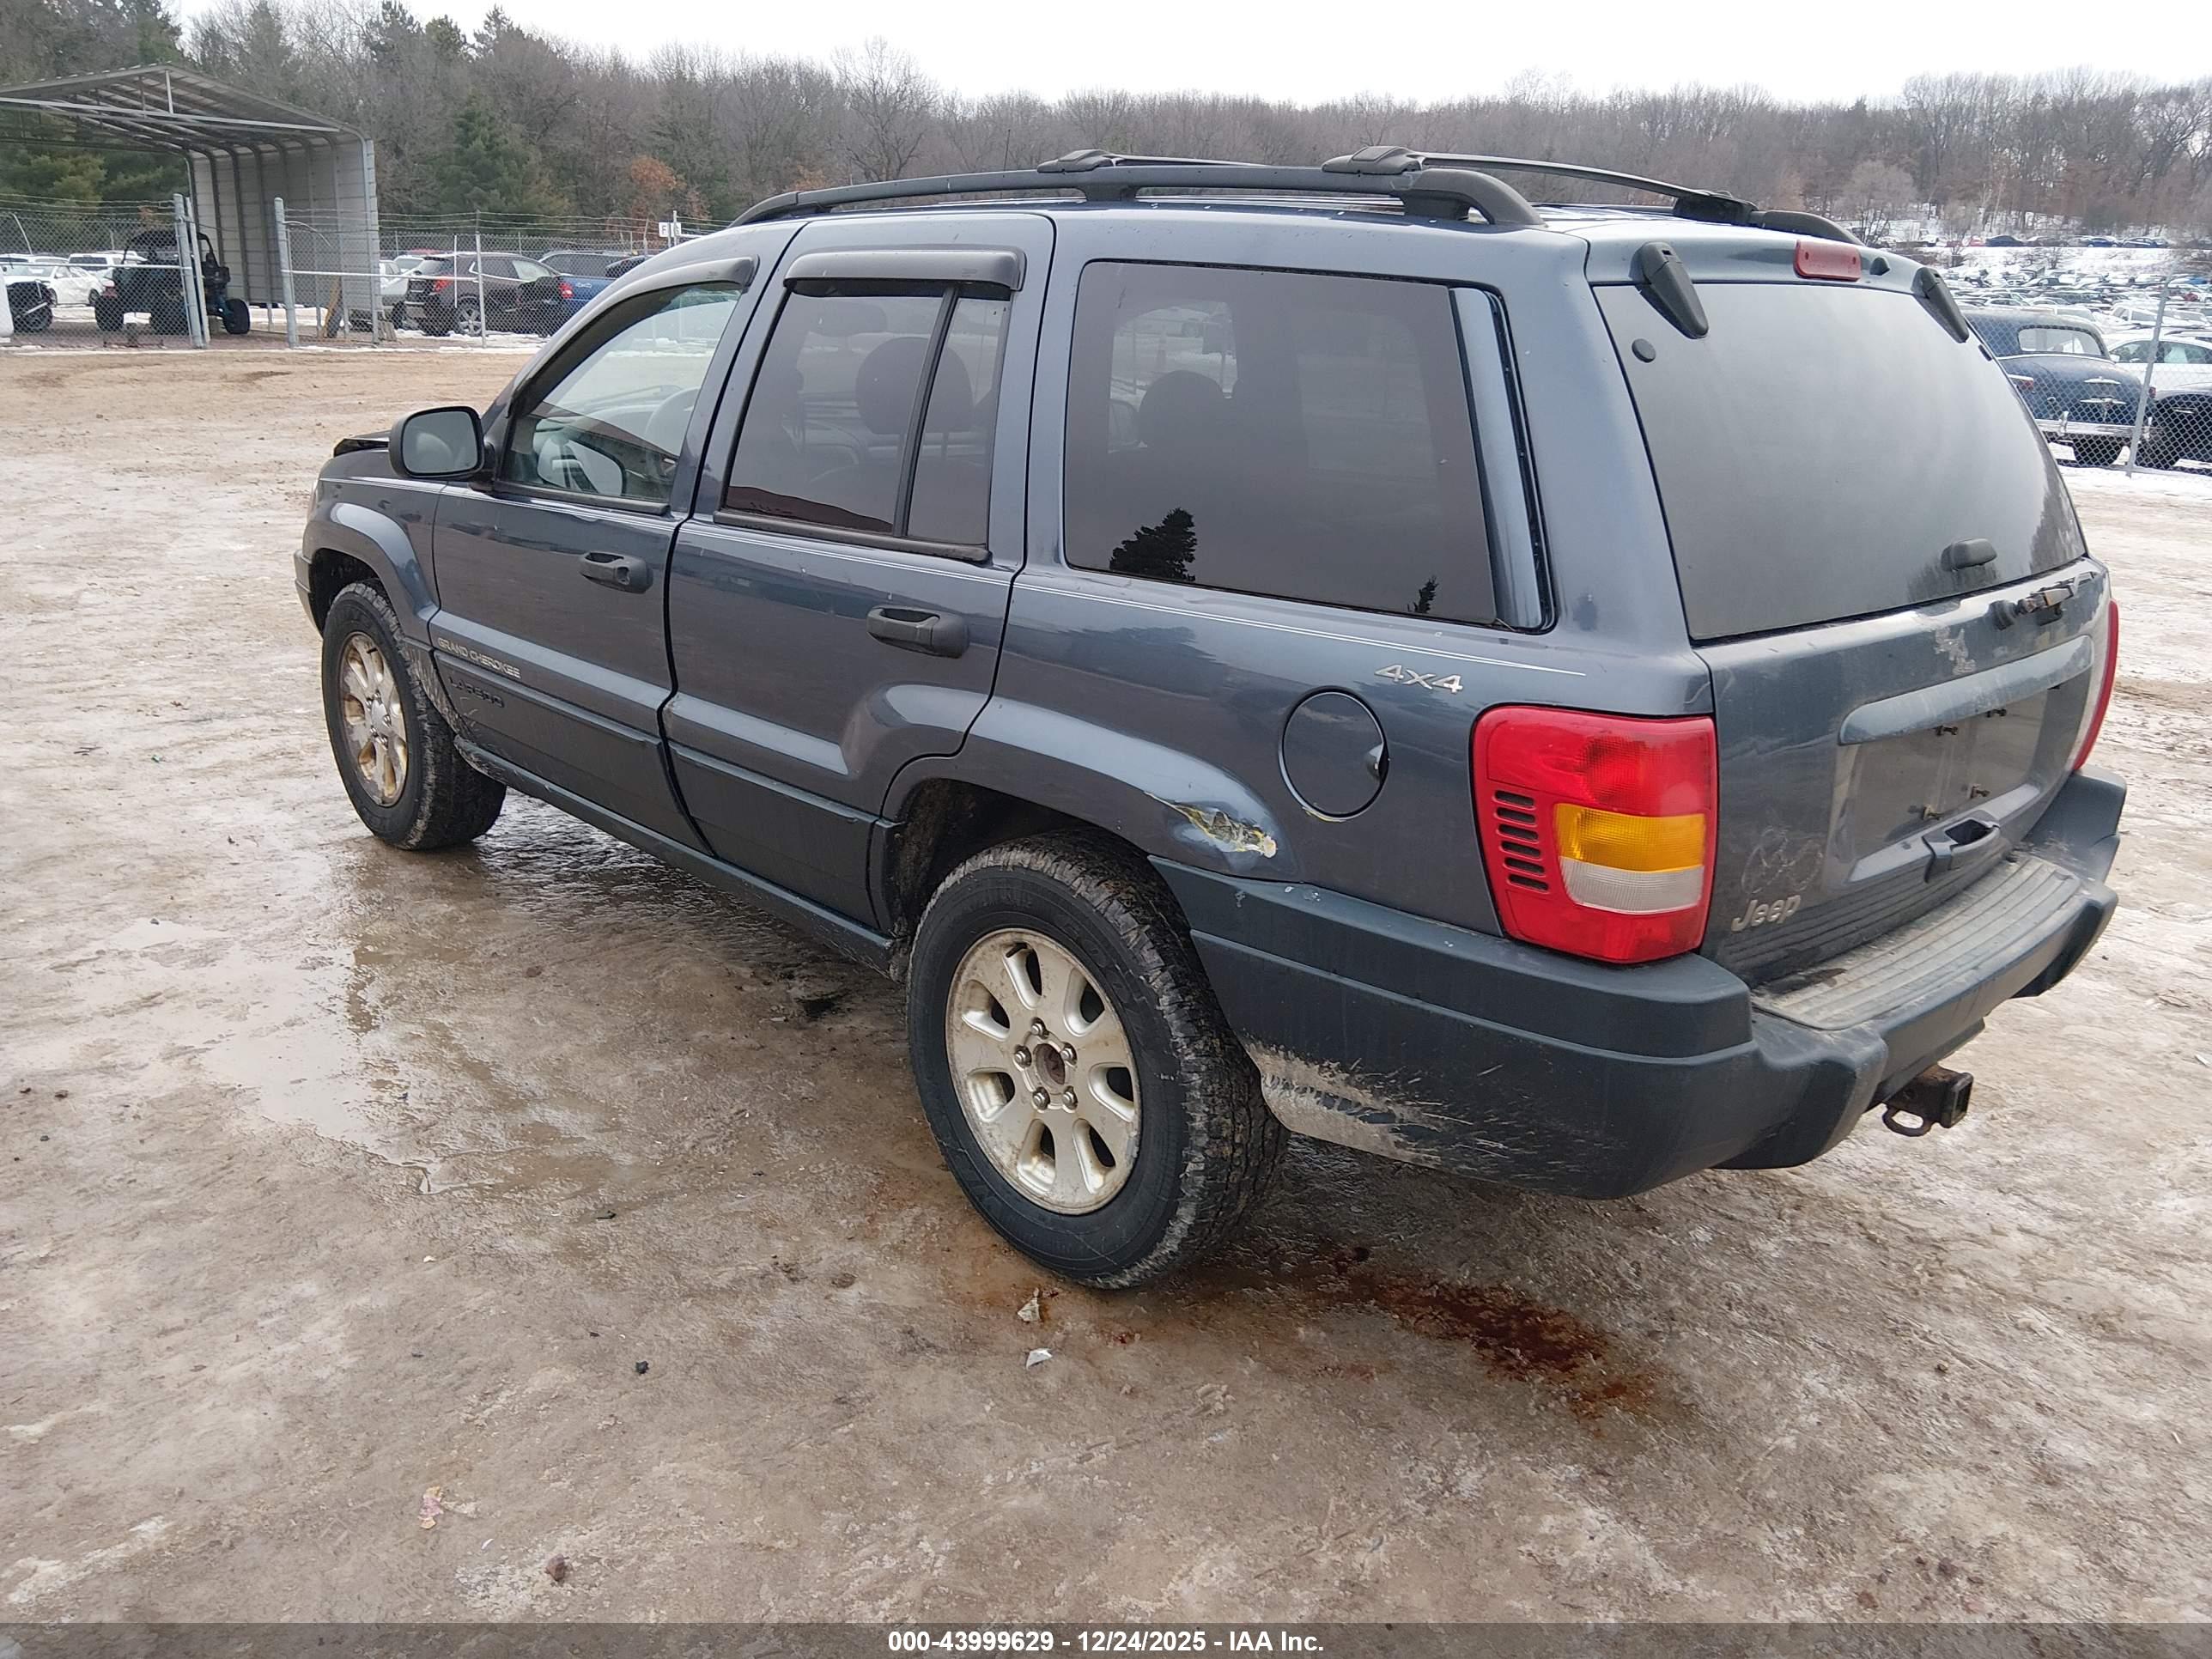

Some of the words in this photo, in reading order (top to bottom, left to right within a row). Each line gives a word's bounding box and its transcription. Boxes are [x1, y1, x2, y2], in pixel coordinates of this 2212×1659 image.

[438, 637, 468, 658] GRAND
[469, 650, 521, 679] CHEROKEE
[1731, 895, 1801, 933] Jeep
